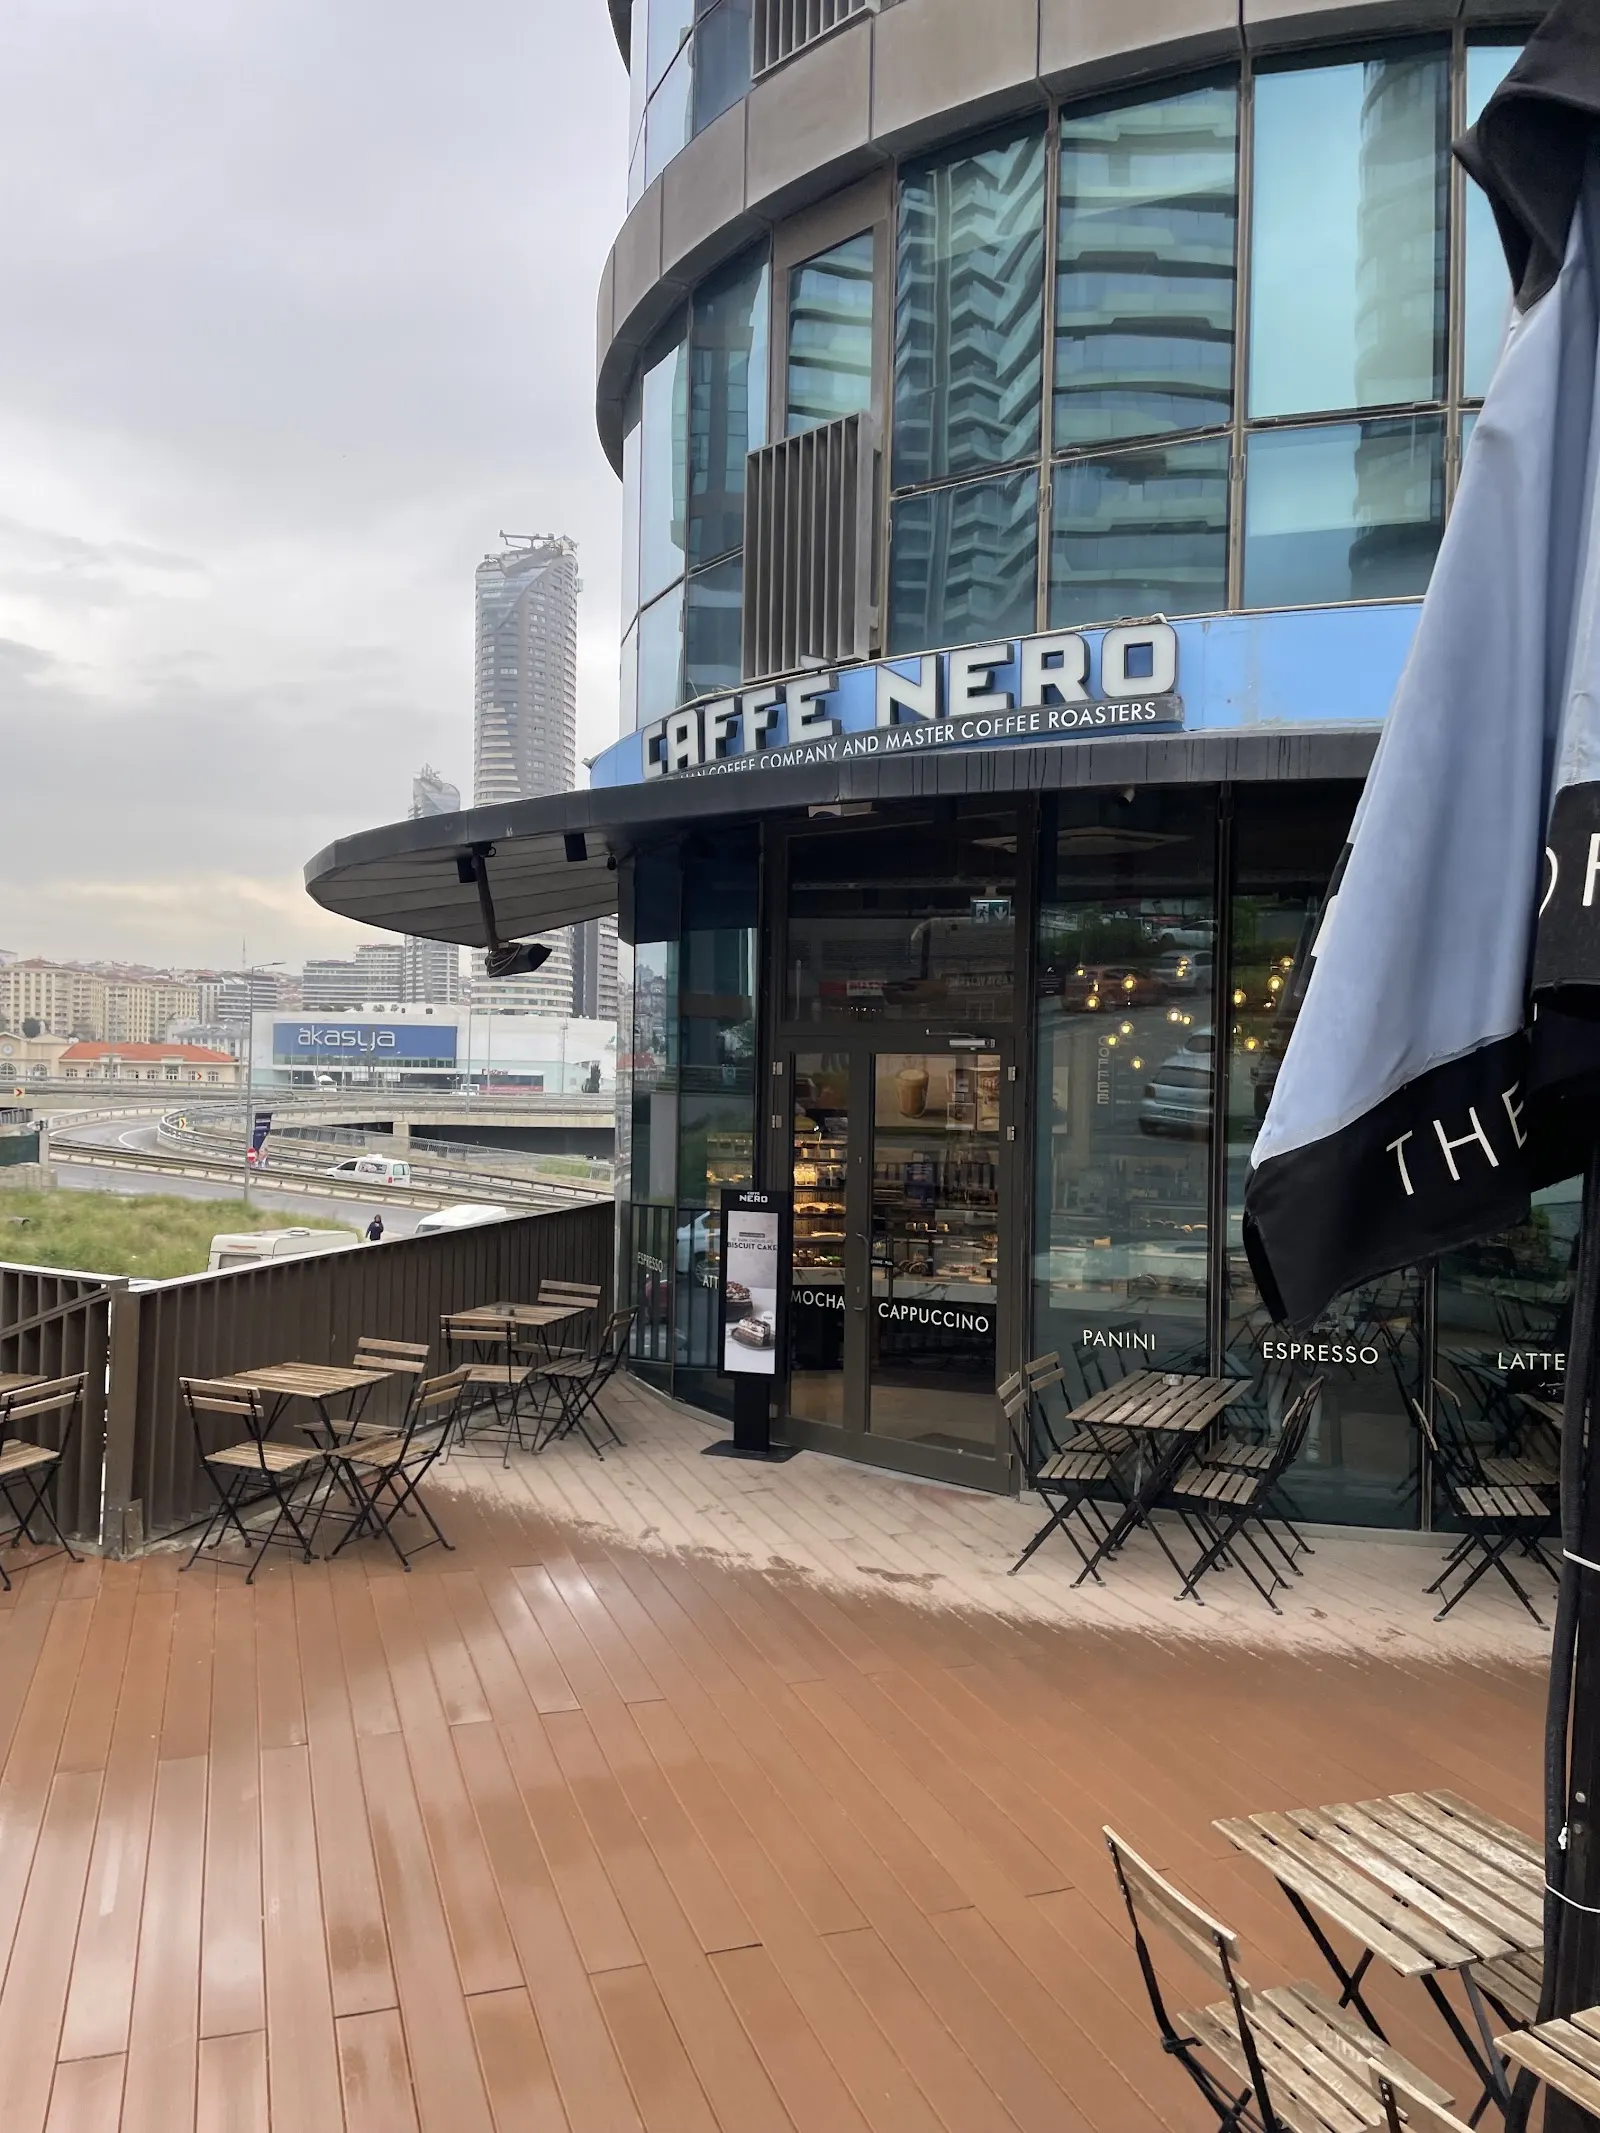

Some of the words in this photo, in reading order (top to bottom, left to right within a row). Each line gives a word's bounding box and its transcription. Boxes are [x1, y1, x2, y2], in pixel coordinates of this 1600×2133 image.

[875, 623, 1177, 727] NERO
[760, 742, 838, 769] COMPANY
[842, 735, 879, 757] AND
[885, 724, 955, 750] MASTER
[961, 713, 1040, 739] COFFEE
[1048, 701, 1157, 729] ROASTERS
[298, 1025, 395, 1052] akasya
[1386, 1081, 1528, 1196] THE
[739, 1194, 768, 1203] NERO
[727, 1242, 755, 1250] BISCUIT
[757, 1243, 778, 1251] CAKE
[637, 1252, 664, 1273] ESPRESSO
[790, 1290, 846, 1311] MOCHA
[878, 1302, 989, 1333] CAPPUCCINO
[1083, 1329, 1155, 1351] PANINI
[1263, 1341, 1379, 1365] ESPRESSO
[1497, 1351, 1566, 1371] LATTE
